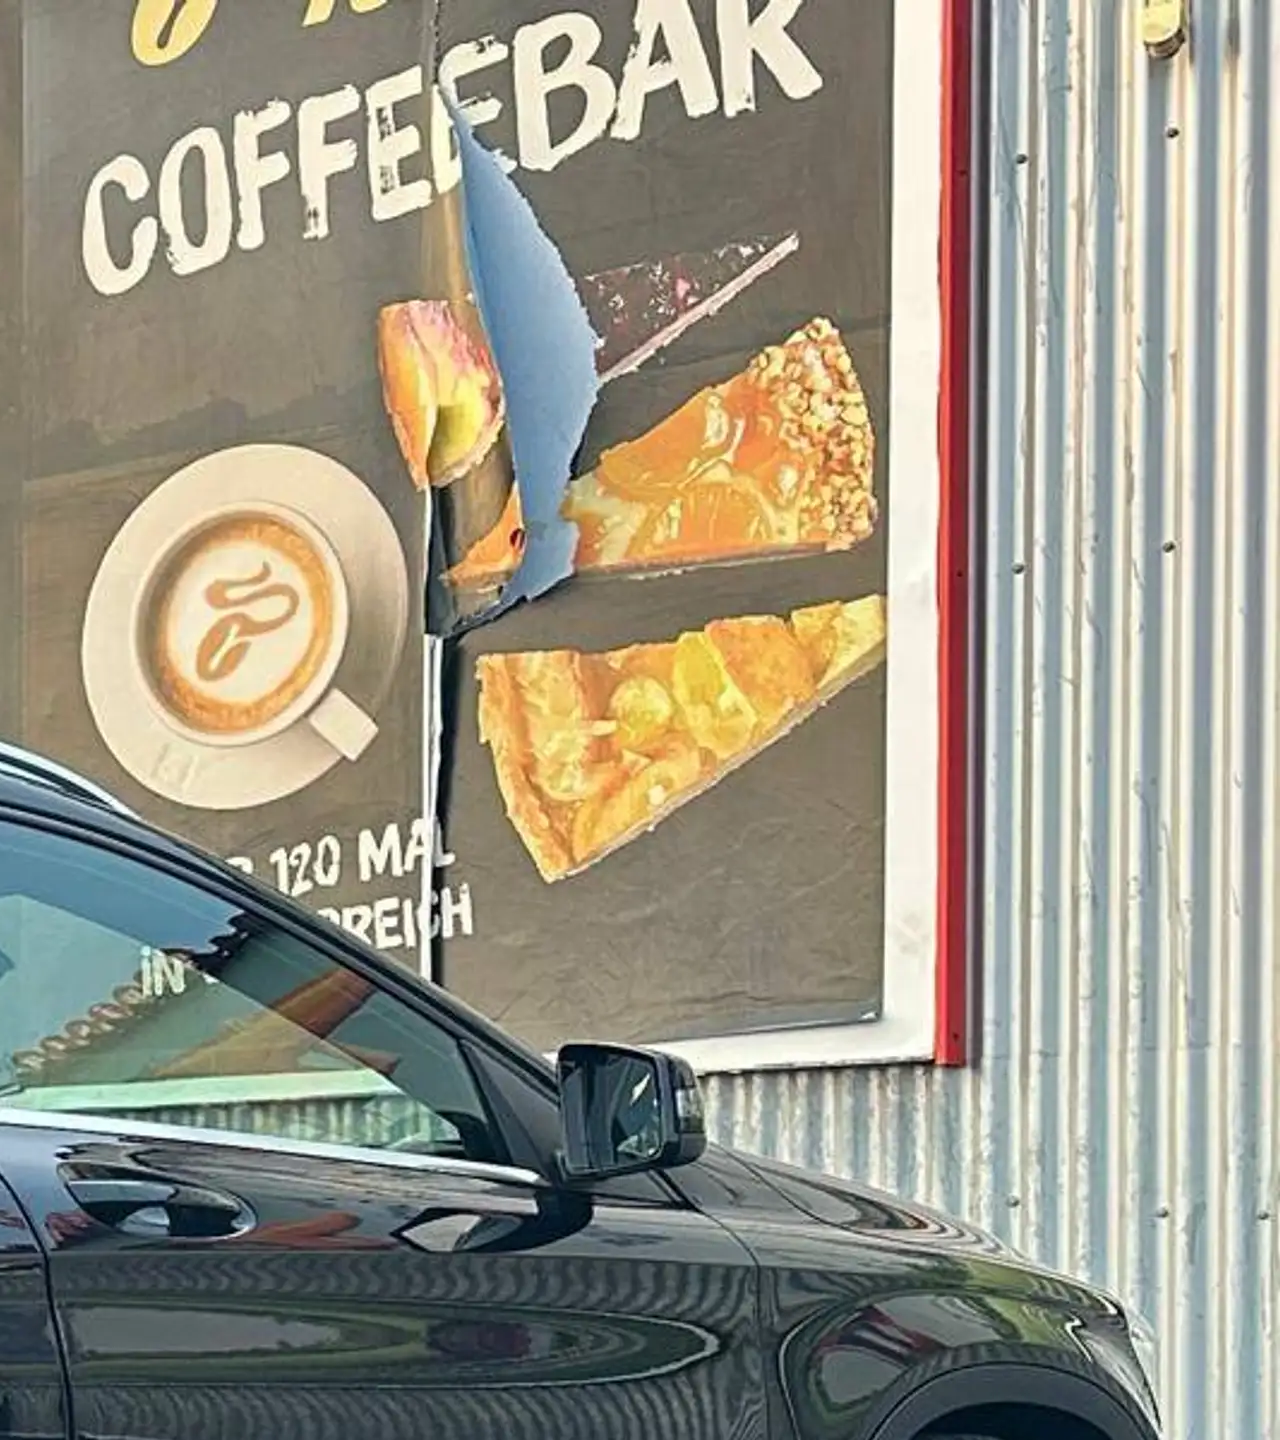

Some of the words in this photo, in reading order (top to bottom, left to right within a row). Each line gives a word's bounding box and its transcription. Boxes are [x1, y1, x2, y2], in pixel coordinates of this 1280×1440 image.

[82, 0, 823, 296] COFFEEBAR
[269, 835, 341, 897] 120
[358, 816, 456, 882] MAL
